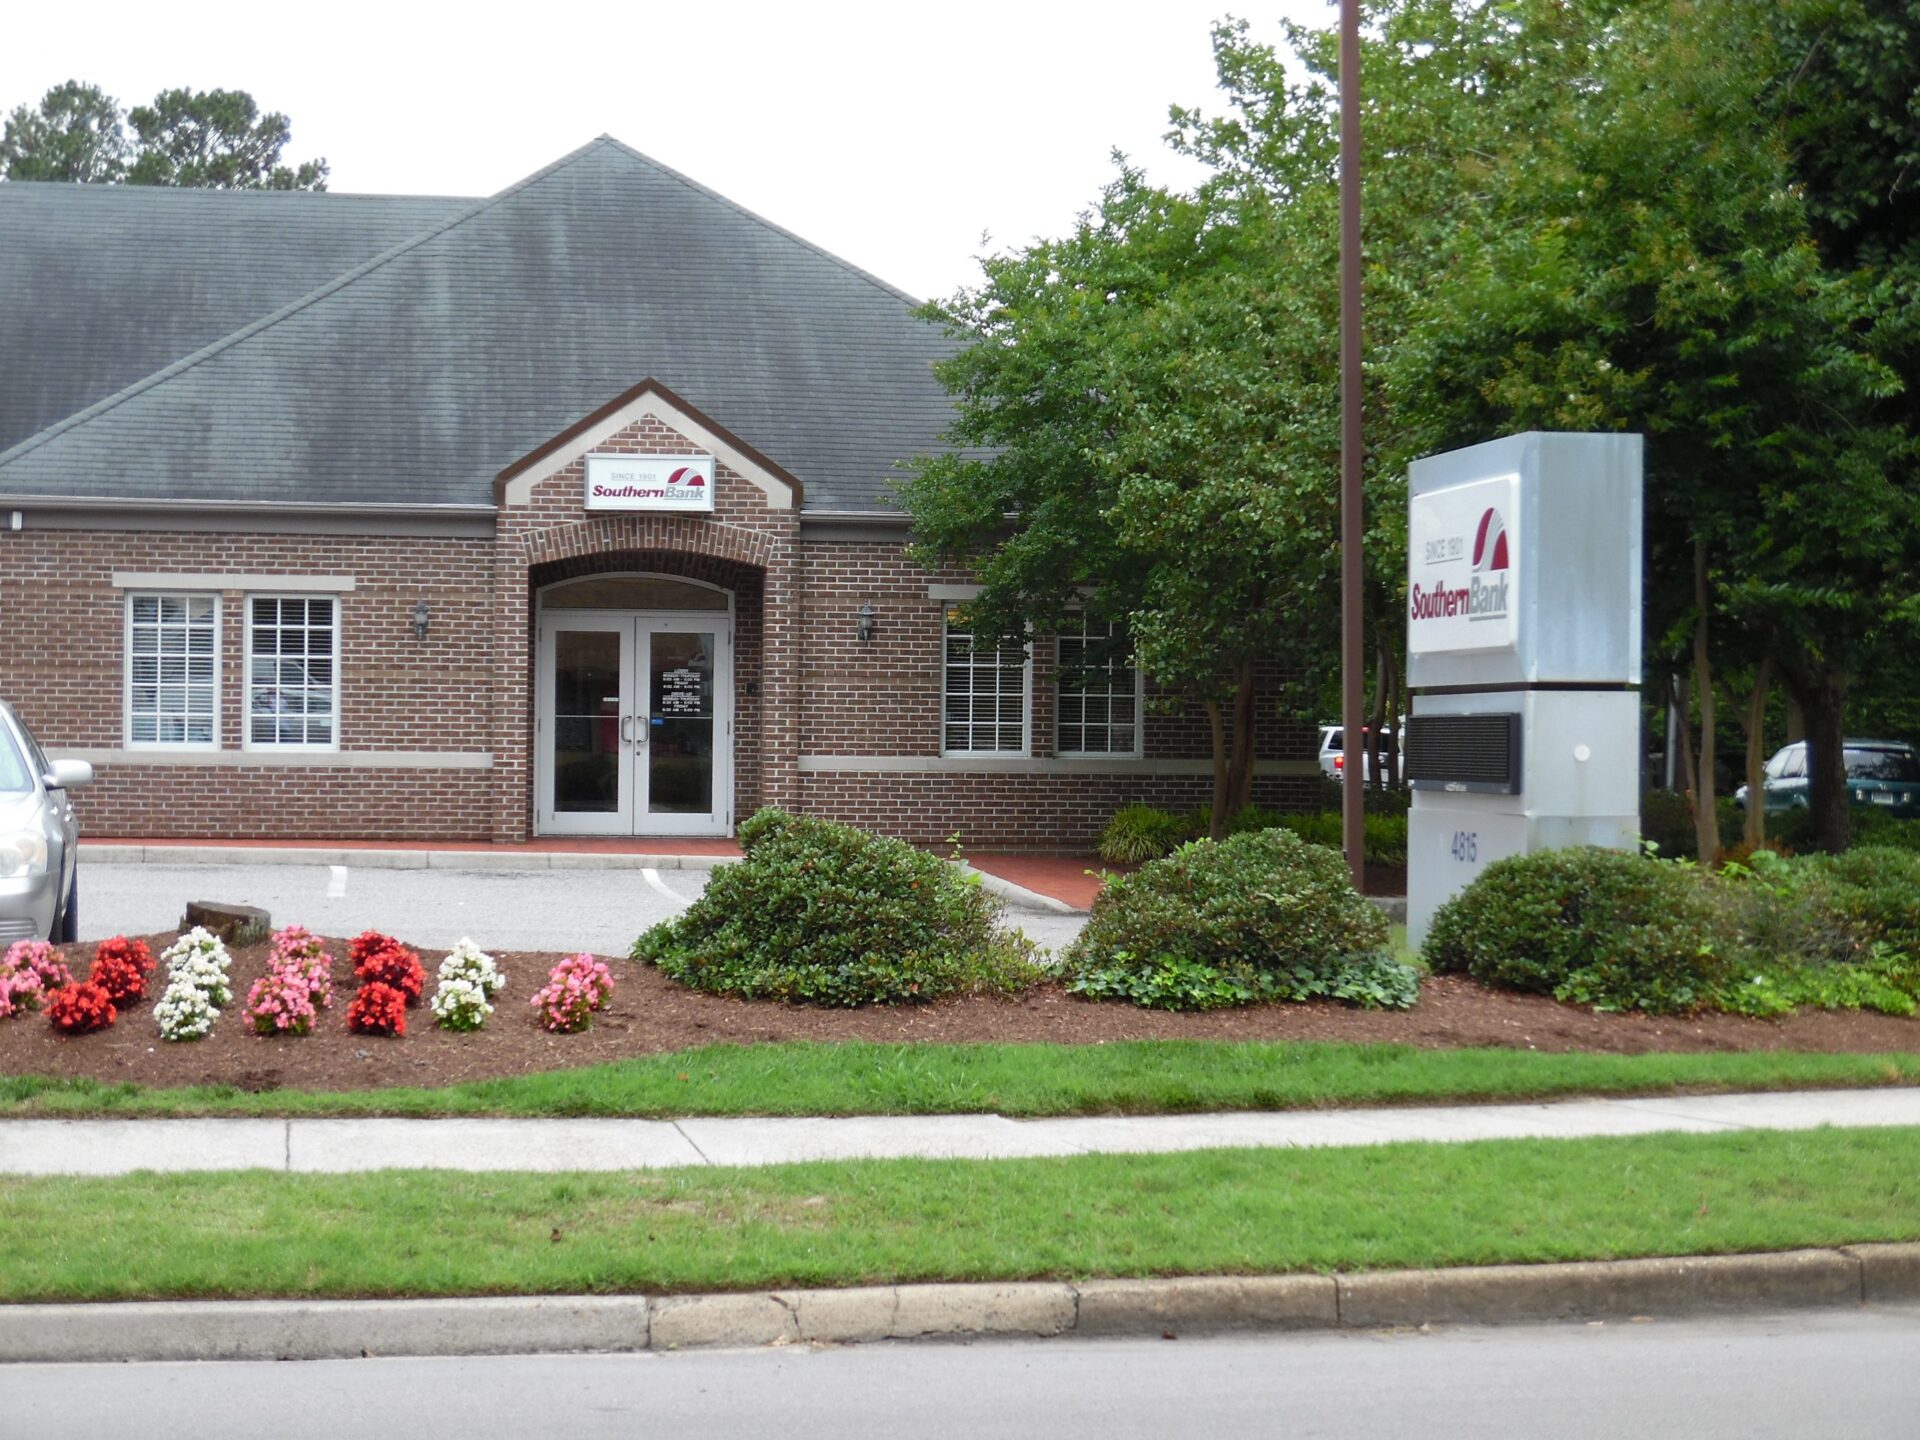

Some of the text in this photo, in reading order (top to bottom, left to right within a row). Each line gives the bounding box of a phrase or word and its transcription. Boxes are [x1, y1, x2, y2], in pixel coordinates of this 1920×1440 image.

[610, 472, 657, 480] SINCE 1901
[1451, 830, 1477, 863] 4815
